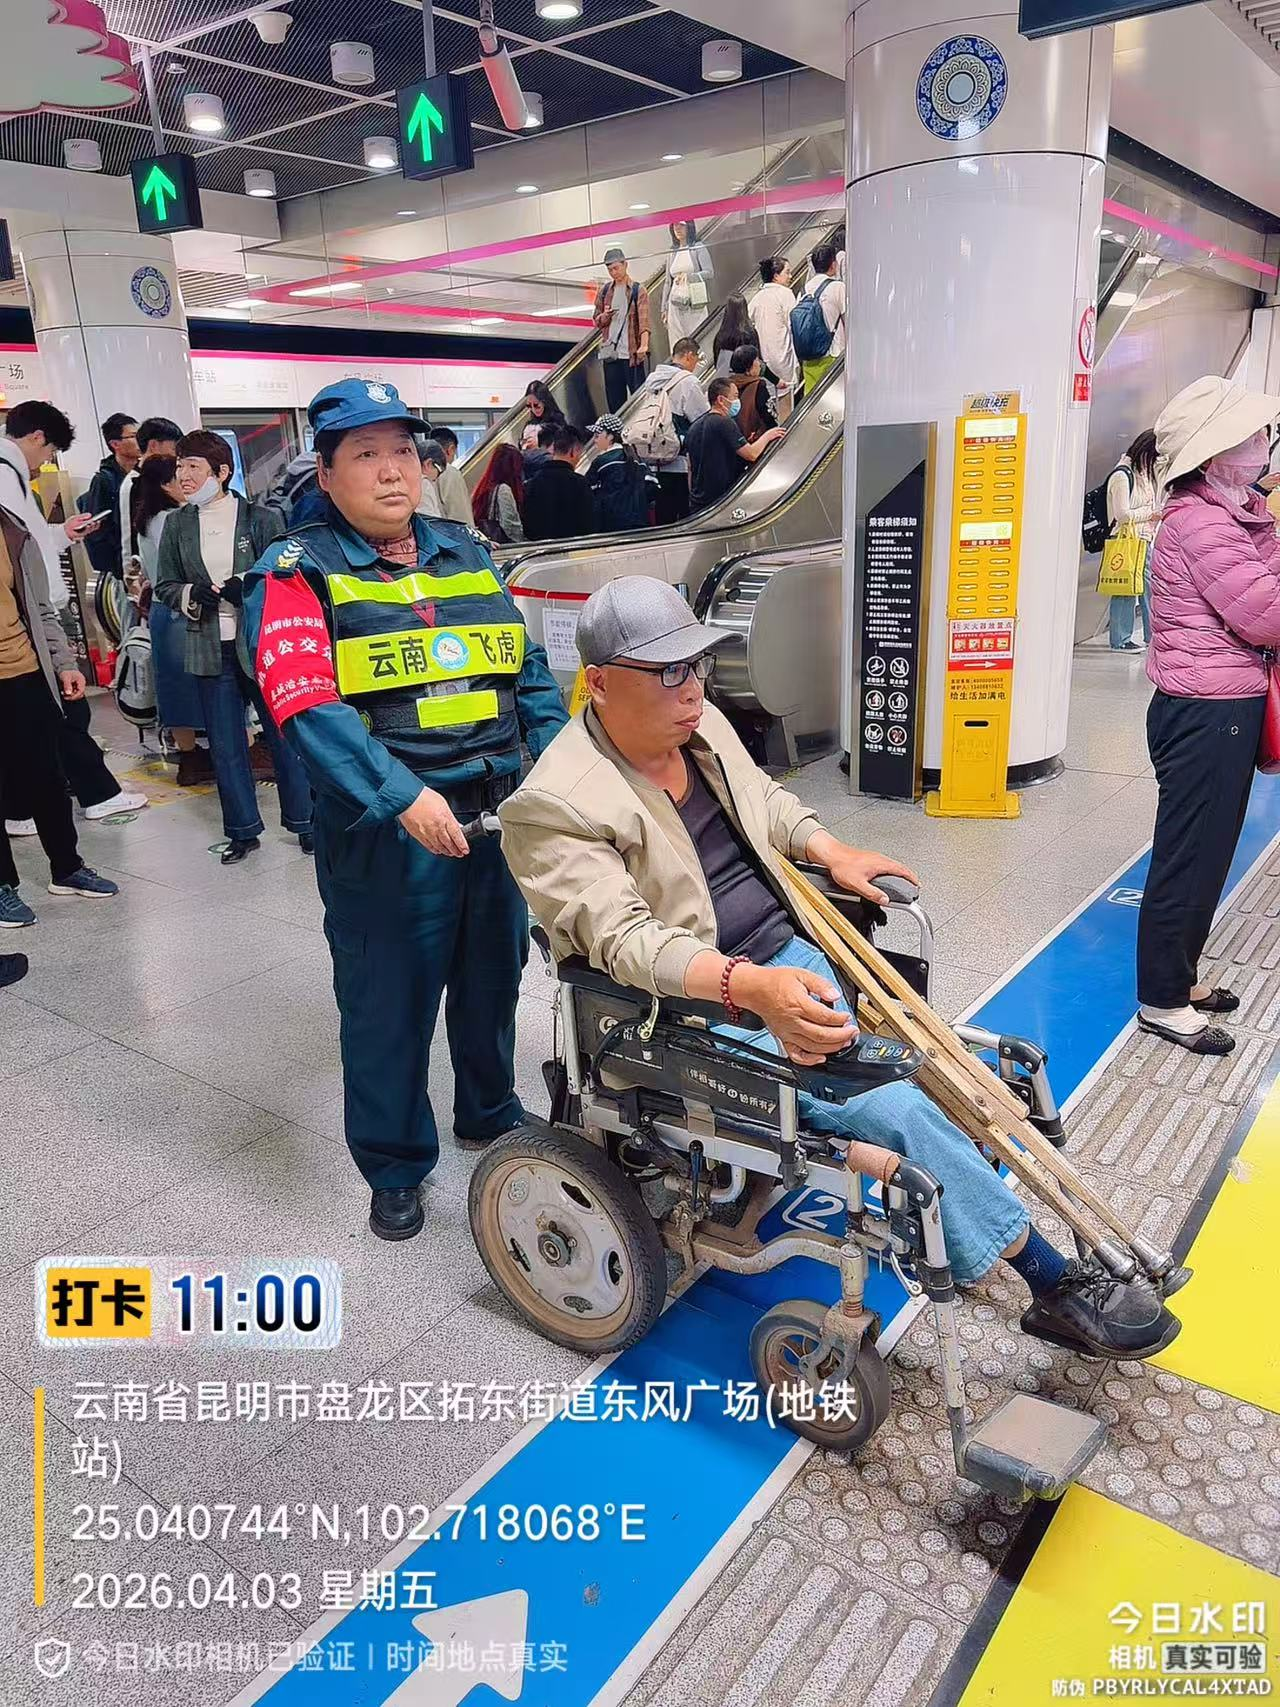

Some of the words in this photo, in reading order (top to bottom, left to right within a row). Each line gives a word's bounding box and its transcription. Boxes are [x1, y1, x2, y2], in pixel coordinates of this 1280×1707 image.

[869, 517, 918, 528] 乘客乘梯须知
[264, 616, 323, 636] 昆明市公安局
[368, 636, 430, 679] 云南
[469, 629, 518, 667] 飞虎
[950, 691, 1006, 701] 给生活加满电
[796, 1195, 845, 1230] 2
